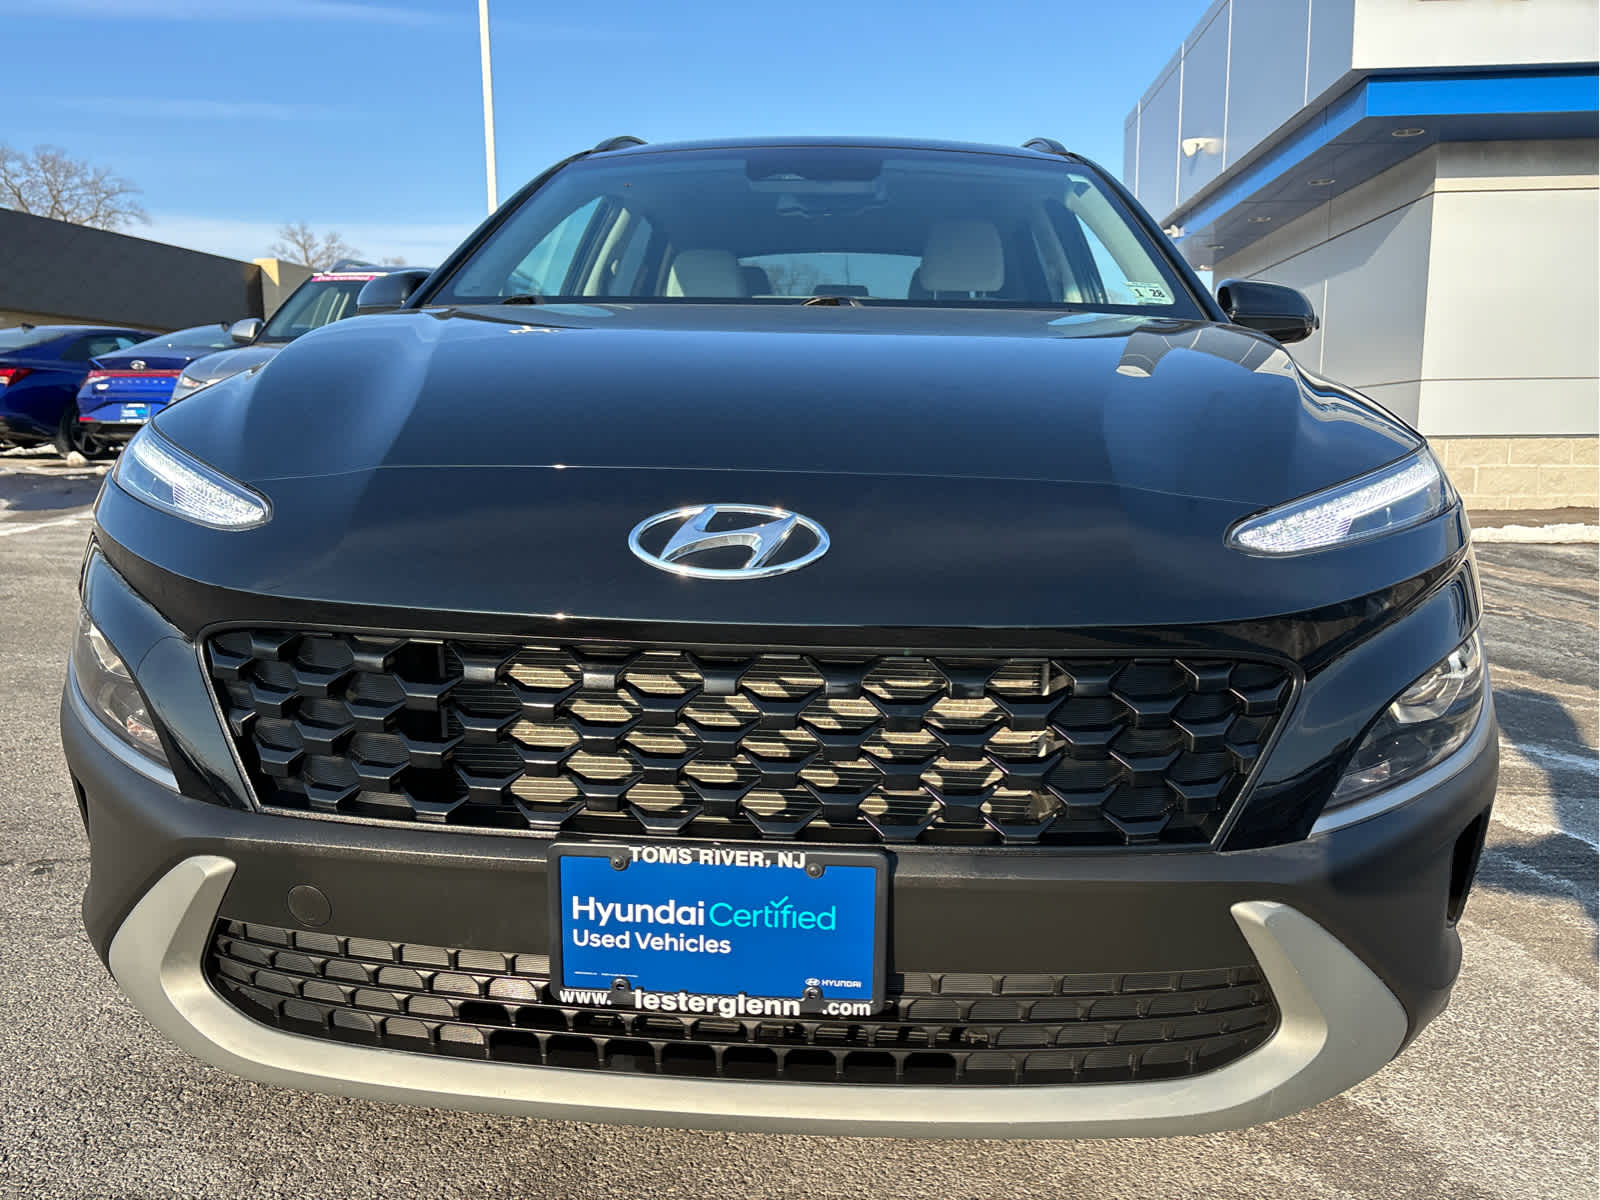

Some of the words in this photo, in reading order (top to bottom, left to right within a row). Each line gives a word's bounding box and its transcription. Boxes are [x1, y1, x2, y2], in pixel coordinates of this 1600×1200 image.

[1135, 288, 1144, 298] 1
[629, 847, 692, 864] TOMS
[699, 848, 771, 868] RIVER,
[778, 851, 806, 869] NJ
[572, 896, 705, 926] Hyundai
[709, 896, 837, 931] Certified
[573, 929, 630, 949] Used
[634, 931, 732, 954] Vehicles
[822, 979, 862, 988] HYUNDAI
[559, 991, 612, 1005] www.
[635, 989, 801, 1018] lesterglenn
[822, 1001, 871, 1016] .com
